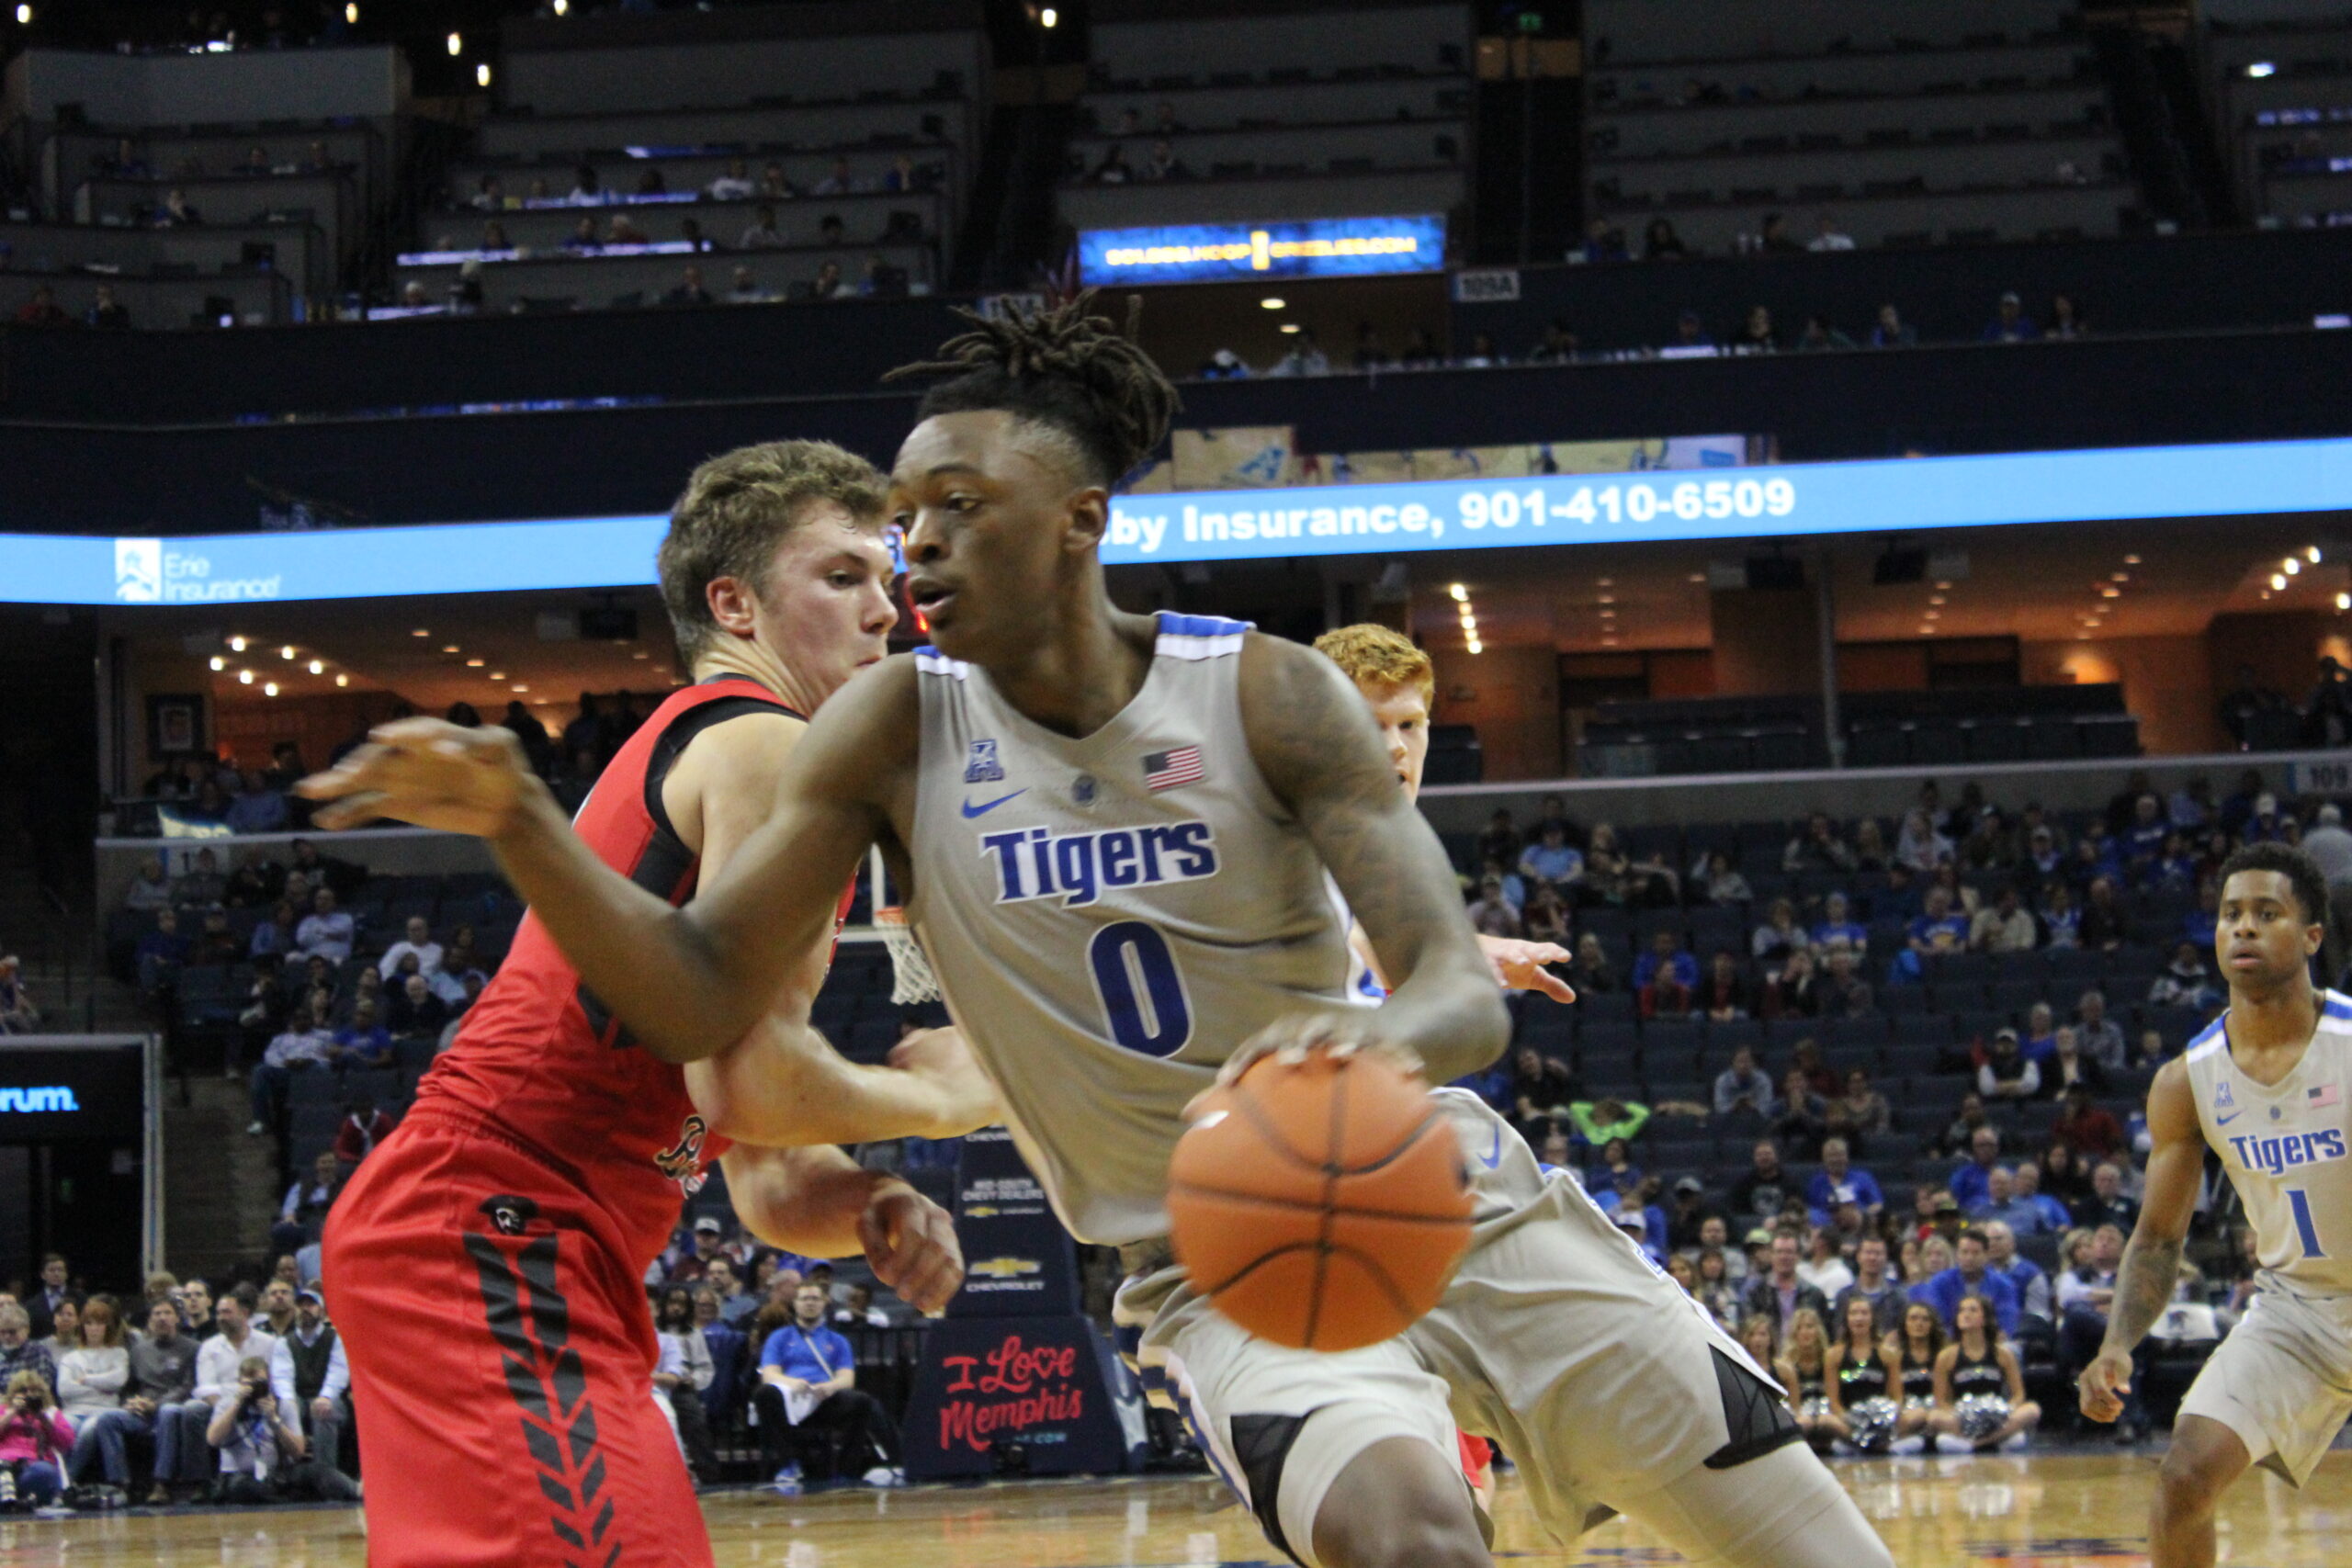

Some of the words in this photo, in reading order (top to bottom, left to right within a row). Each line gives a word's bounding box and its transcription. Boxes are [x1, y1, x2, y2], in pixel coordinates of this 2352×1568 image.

[1100, 508, 1167, 553] by
[1182, 502, 1445, 542] Insurance,
[1458, 478, 1795, 530] 901-410-6509
[164, 553, 211, 579] Erie
[979, 822, 1220, 908] Tigers
[1088, 919, 1194, 1058] 0
[2228, 1128, 2346, 1176] Tigers
[2284, 1189, 2329, 1258] 1
[966, 1281, 1045, 1292] CHEVROLET
[943, 1356, 979, 1393] I
[979, 1336, 1076, 1393] Love
[940, 1382, 1082, 1451] Memphis
